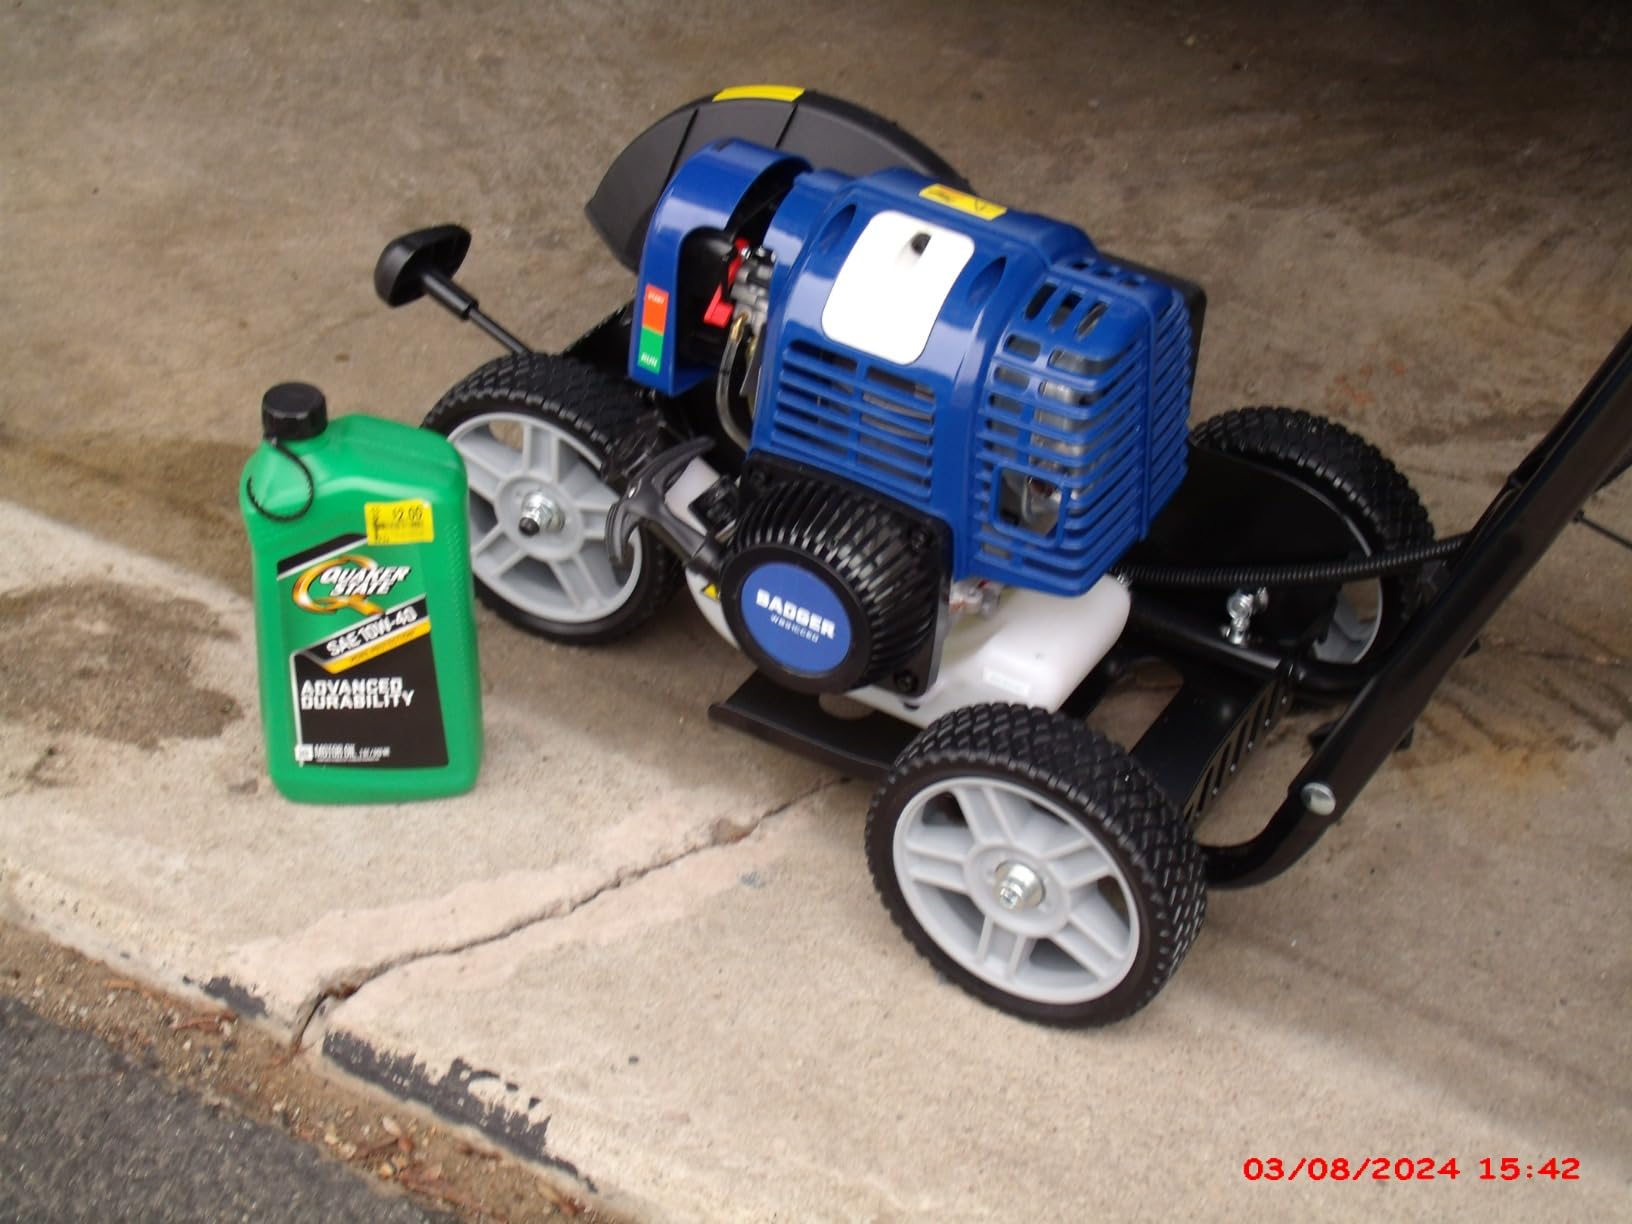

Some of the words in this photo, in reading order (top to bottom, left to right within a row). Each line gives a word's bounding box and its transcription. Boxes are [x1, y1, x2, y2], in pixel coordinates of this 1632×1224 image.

[319, 565, 412, 585] QUAKER
[329, 581, 395, 597] STATE
[755, 588, 836, 640] BADGER
[326, 631, 361, 657] SAE
[301, 677, 403, 697] ADVANCED
[300, 690, 415, 710] DURABILITY
